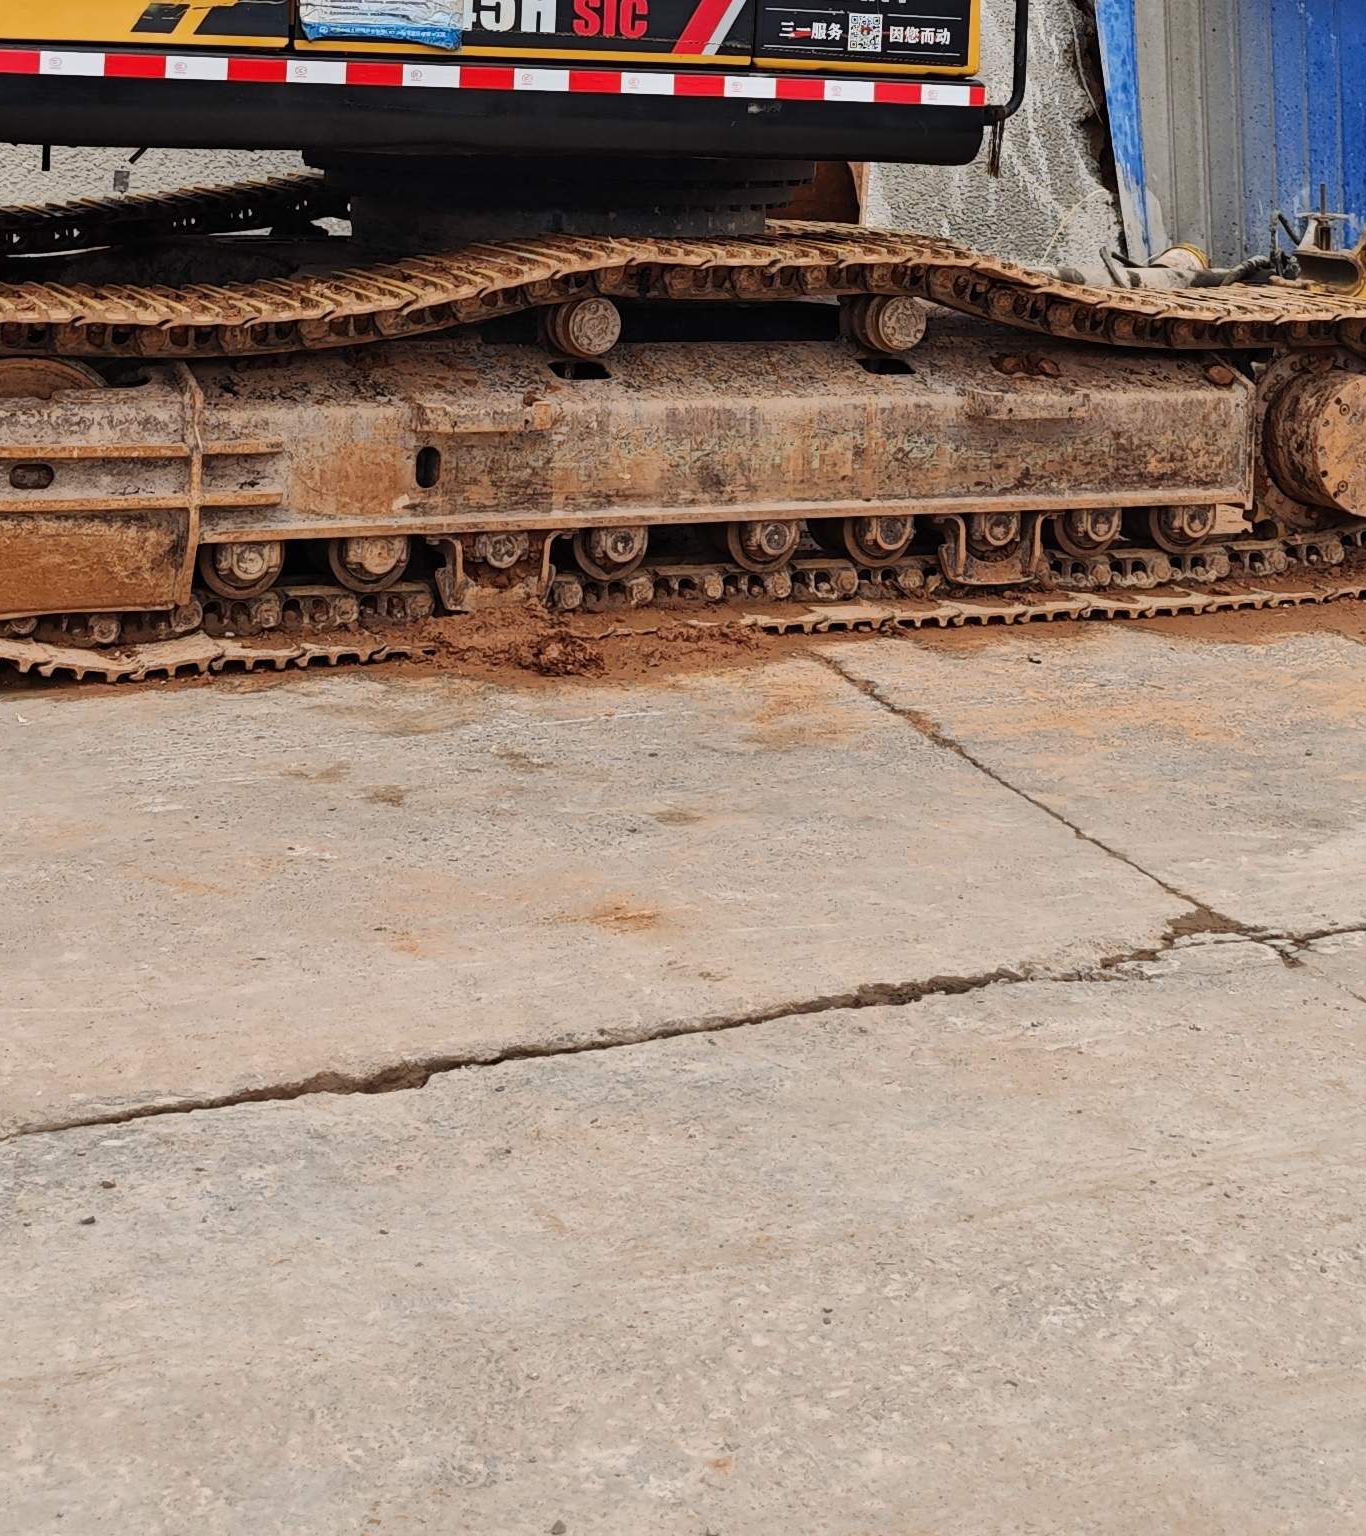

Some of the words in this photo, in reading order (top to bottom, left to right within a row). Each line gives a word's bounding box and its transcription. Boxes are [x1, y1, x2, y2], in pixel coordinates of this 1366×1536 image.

[778, 21, 843, 41] 三一服务
[889, 25, 951, 45] 因您而动
